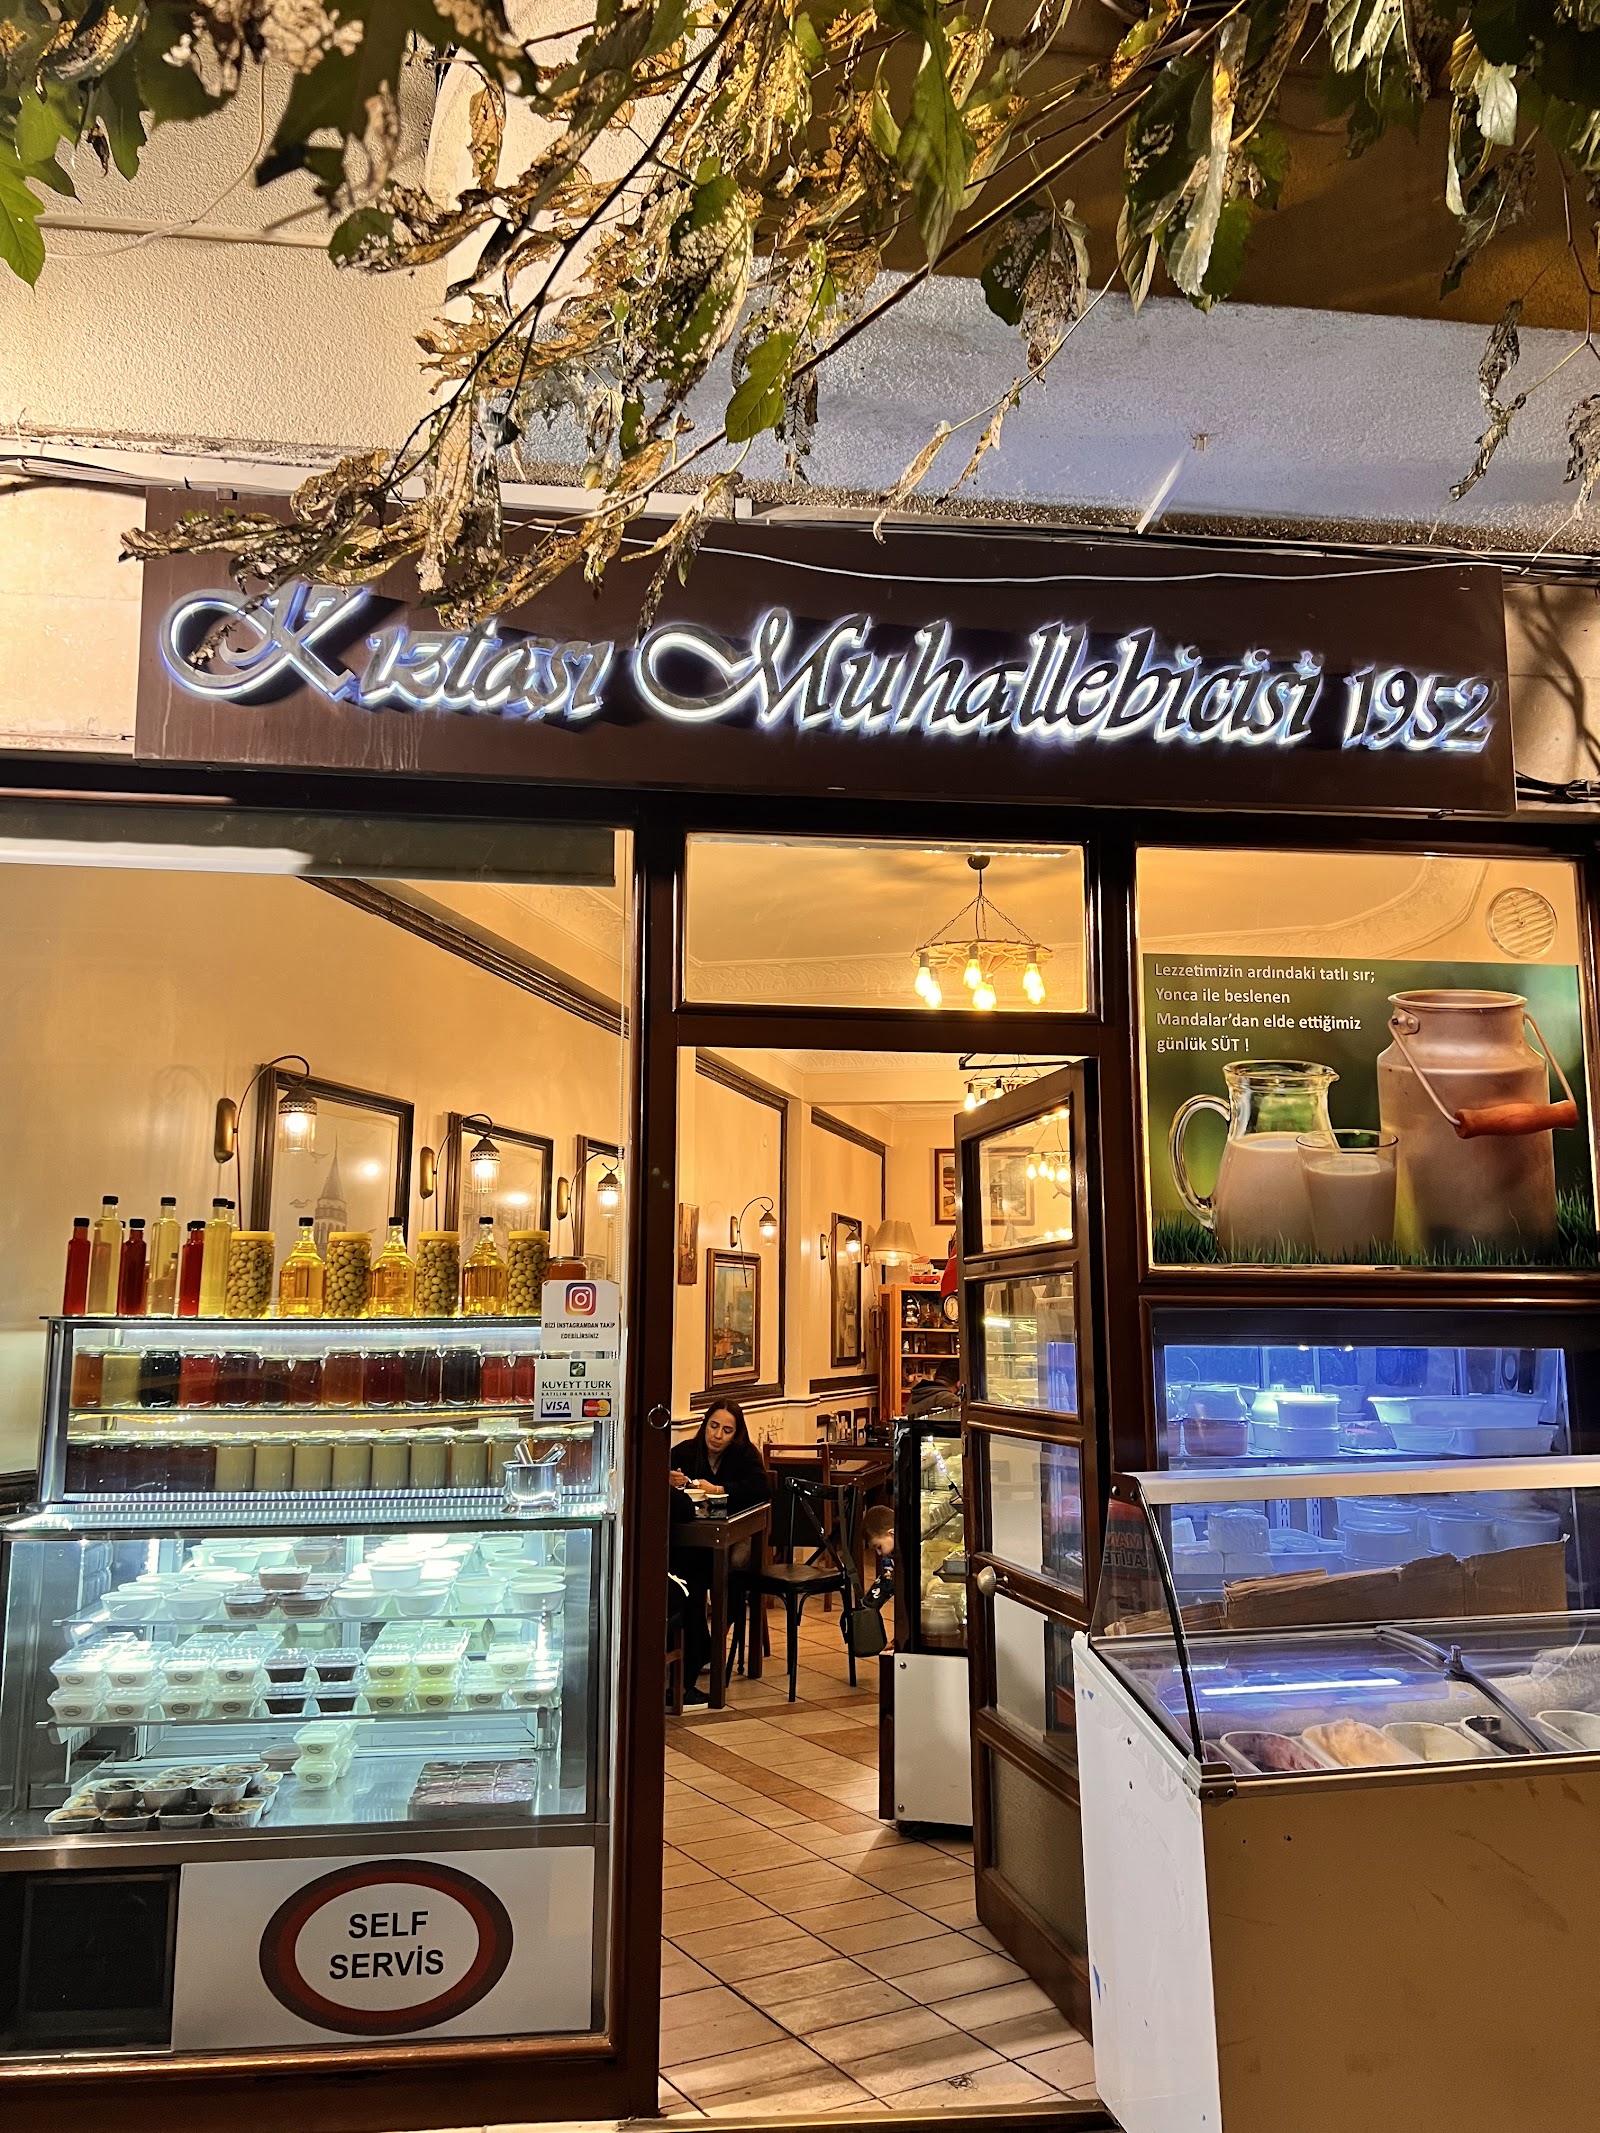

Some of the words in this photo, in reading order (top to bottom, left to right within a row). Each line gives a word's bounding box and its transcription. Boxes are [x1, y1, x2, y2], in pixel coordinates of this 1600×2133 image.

[632, 605, 1324, 748] Muhallebicisi
[1342, 663, 1500, 752] 1952
[1154, 962, 1244, 979] Lezzetimizin
[1247, 965, 1316, 980] ardındaki
[1319, 966, 1349, 981] tatlı
[1352, 969, 1376, 983] sır;
[1155, 987, 1198, 1002] Yonca
[1202, 987, 1220, 1002] ile
[1224, 989, 1291, 1004] beslenen
[1263, 1014, 1295, 1029] elde
[1298, 1014, 1362, 1032] ettiğimiz
[1156, 1035, 1208, 1054] günlük
[1211, 1034, 1240, 1052] SÜT
[1243, 1037, 1250, 1052] !
[541, 1380, 582, 1389] KUVEYT
[545, 1401, 570, 1411] VISA
[347, 1910, 429, 1939] SELF
[328, 1945, 444, 1980] SERVİS
